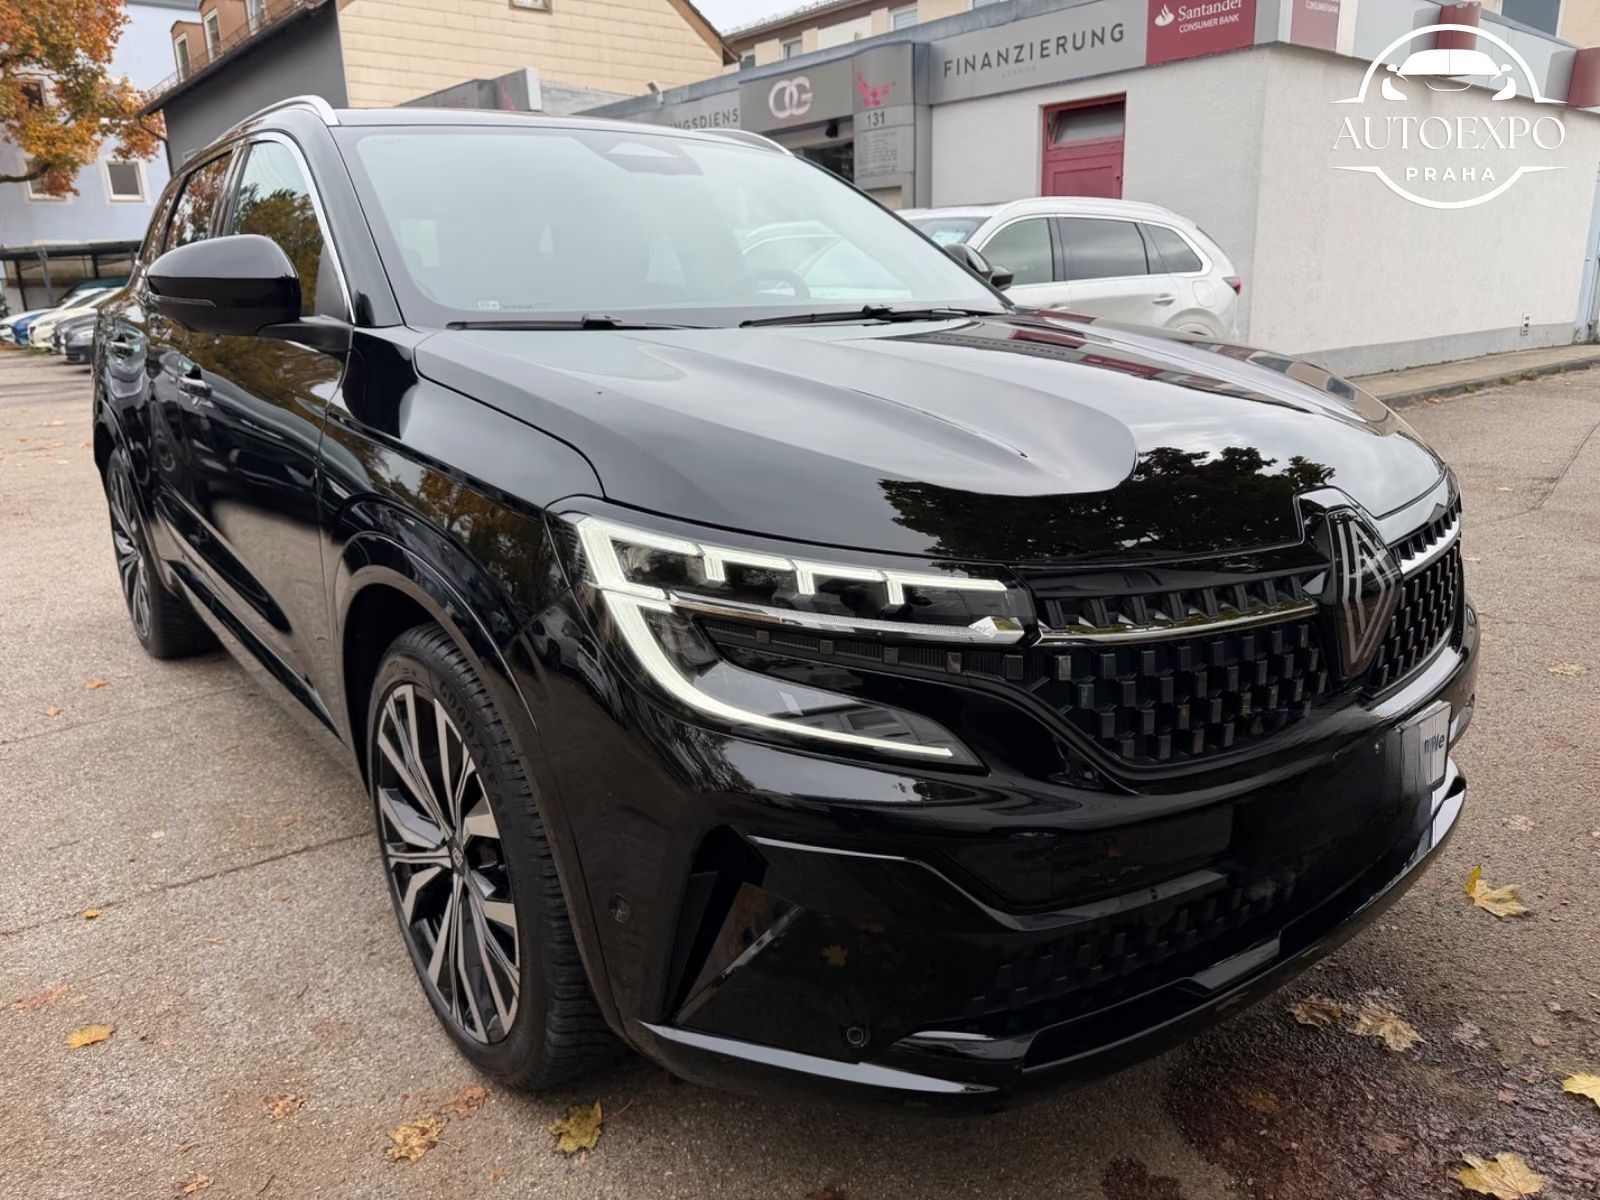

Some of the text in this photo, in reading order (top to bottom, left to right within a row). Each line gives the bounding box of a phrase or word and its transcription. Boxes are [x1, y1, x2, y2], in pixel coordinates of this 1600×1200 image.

[1178, 0, 1242, 21] Santander
[1179, 13, 1239, 33] CONSUMER BANK
[943, 22, 1125, 78] FINANZIERUNG
[866, 111, 886, 127] 131
